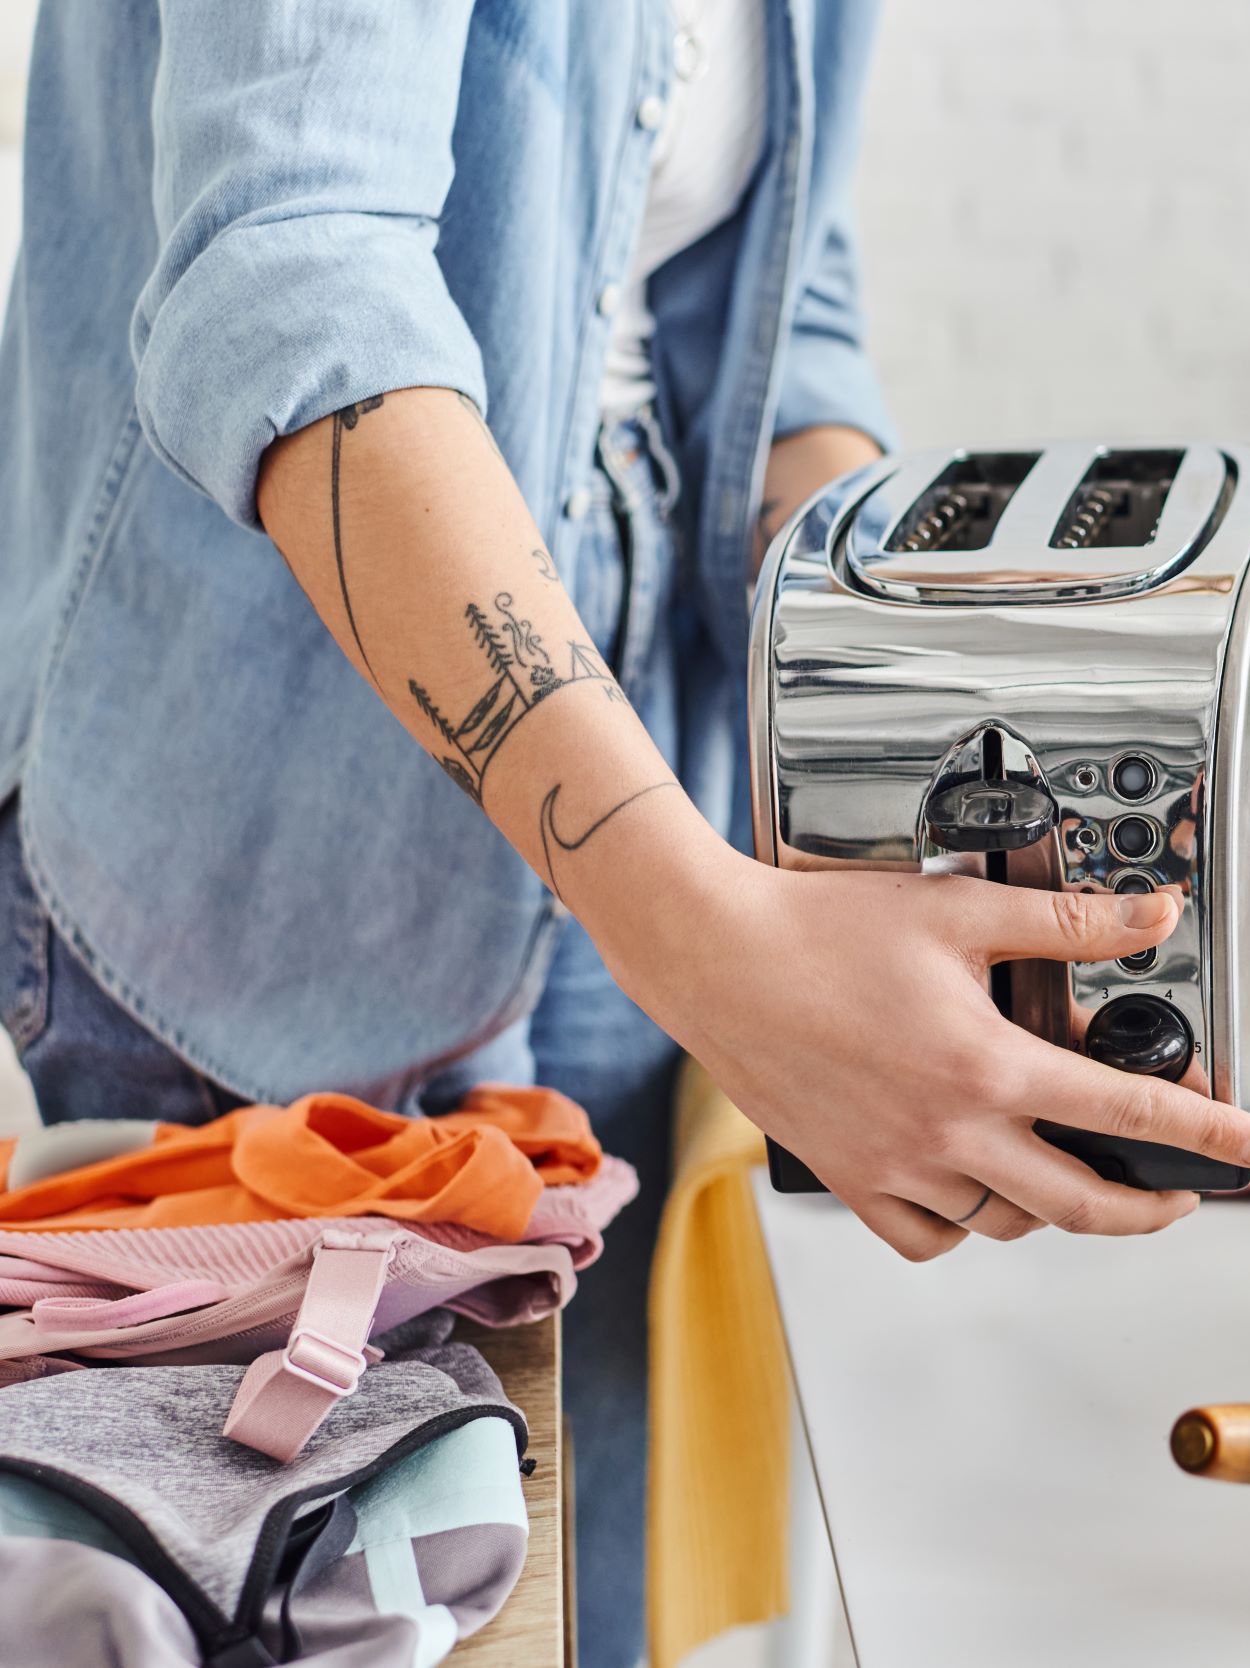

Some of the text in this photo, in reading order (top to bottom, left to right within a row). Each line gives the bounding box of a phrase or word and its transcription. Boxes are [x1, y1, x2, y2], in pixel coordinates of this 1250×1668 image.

[1101, 987, 1109, 1000] 3
[1164, 988, 1173, 1001] 4
[1194, 1041, 1202, 1054] 5
